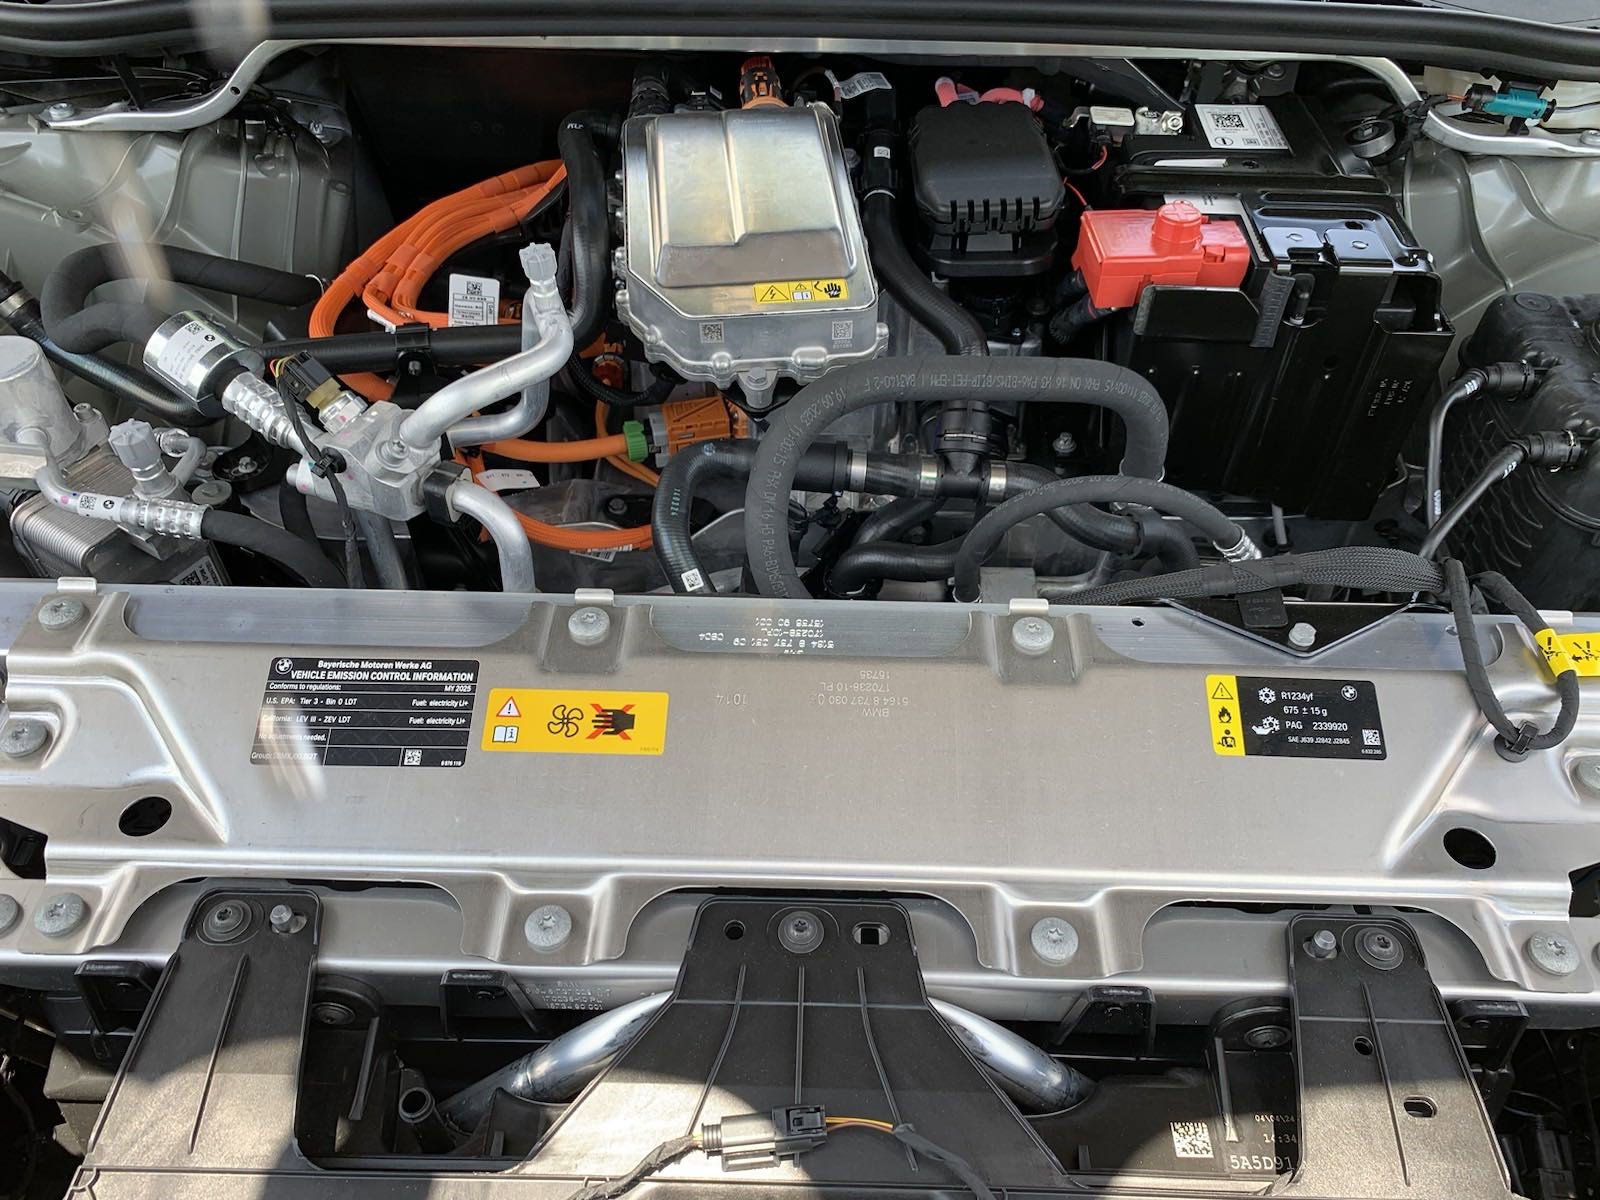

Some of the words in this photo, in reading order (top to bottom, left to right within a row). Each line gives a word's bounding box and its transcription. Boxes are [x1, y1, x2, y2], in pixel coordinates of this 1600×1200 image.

[318, 660, 359, 670] Bayerische
[360, 661, 393, 669] Motoren
[395, 661, 419, 669] Werke
[420, 662, 432, 670] AG
[291, 670, 326, 680] VEHICLE
[327, 671, 369, 681] EMISSION
[370, 672, 411, 681] CONTROL
[412, 672, 474, 682] INFORMATION
[269, 682, 298, 690] Conforms
[306, 684, 342, 692] regulations:
[281, 697, 295, 705] EPA:
[300, 697, 312, 705] Tier
[850, 696, 871, 705] 737
[873, 696, 880, 705] 8
[1281, 692, 1313, 702] R1234yf
[429, 699, 458, 708] electricity
[863, 708, 889, 717] BMW
[1283, 706, 1299, 714] 675
[1302, 707, 1308, 715] ±
[1310, 707, 1320, 715] 15
[1321, 709, 1328, 717] g
[296, 715, 308, 723] LEV
[338, 716, 351, 724] LDT
[426, 717, 456, 726] electricity
[1285, 721, 1303, 729] PAG
[1312, 721, 1348, 731] 2339920
[1230, 1154, 1295, 1170] 5A5D91
